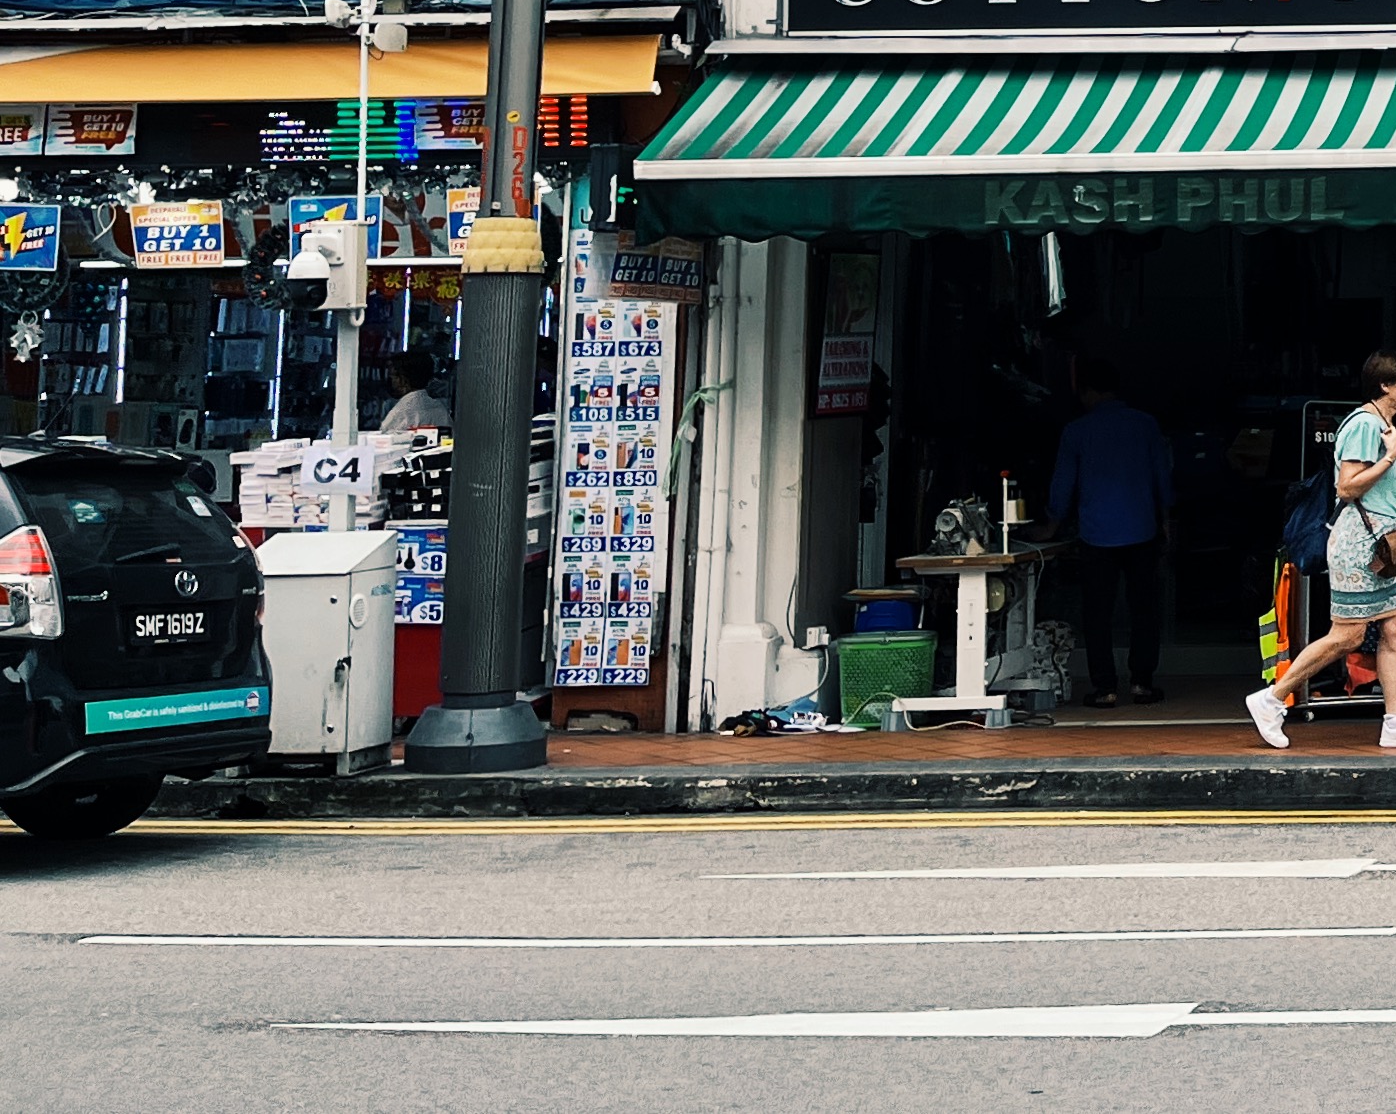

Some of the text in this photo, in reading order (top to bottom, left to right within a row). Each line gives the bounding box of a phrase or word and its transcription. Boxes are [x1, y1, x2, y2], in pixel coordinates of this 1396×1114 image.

[82, 114, 111, 123] BUY
[451, 108, 482, 117] BUY
[451, 117, 480, 126] GET
[985, 175, 1346, 225] KASH PHUL
[147, 224, 210, 239] BUY 1
[143, 238, 217, 252] GET 10
[141, 253, 218, 264] FREE FREE FREE
[620, 255, 653, 269] BUY 1
[665, 259, 697, 274] BUY 1
[614, 269, 656, 283] GET 10
[661, 272, 699, 287] GET 10
[574, 342, 614, 357] $587
[620, 341, 660, 357] $673
[571, 407, 609, 422] $108
[617, 407, 656, 421] $515
[314, 457, 361, 484] C4
[568, 472, 608, 487] $262
[615, 471, 656, 486] $850
[588, 514, 604, 525] 10
[636, 513, 652, 525] 10
[563, 538, 602, 552] $269
[613, 537, 653, 552] $329
[421, 554, 443, 572] $8
[585, 579, 601, 591] 10
[633, 579, 649, 591] 10
[419, 604, 442, 622] $5
[563, 602, 603, 618] $429
[610, 603, 650, 618] $429
[584, 645, 599, 656] 10
[631, 645, 646, 657] 10
[559, 669, 599, 684] $229
[605, 669, 647, 684] $229
[107, 711, 123, 721] This
